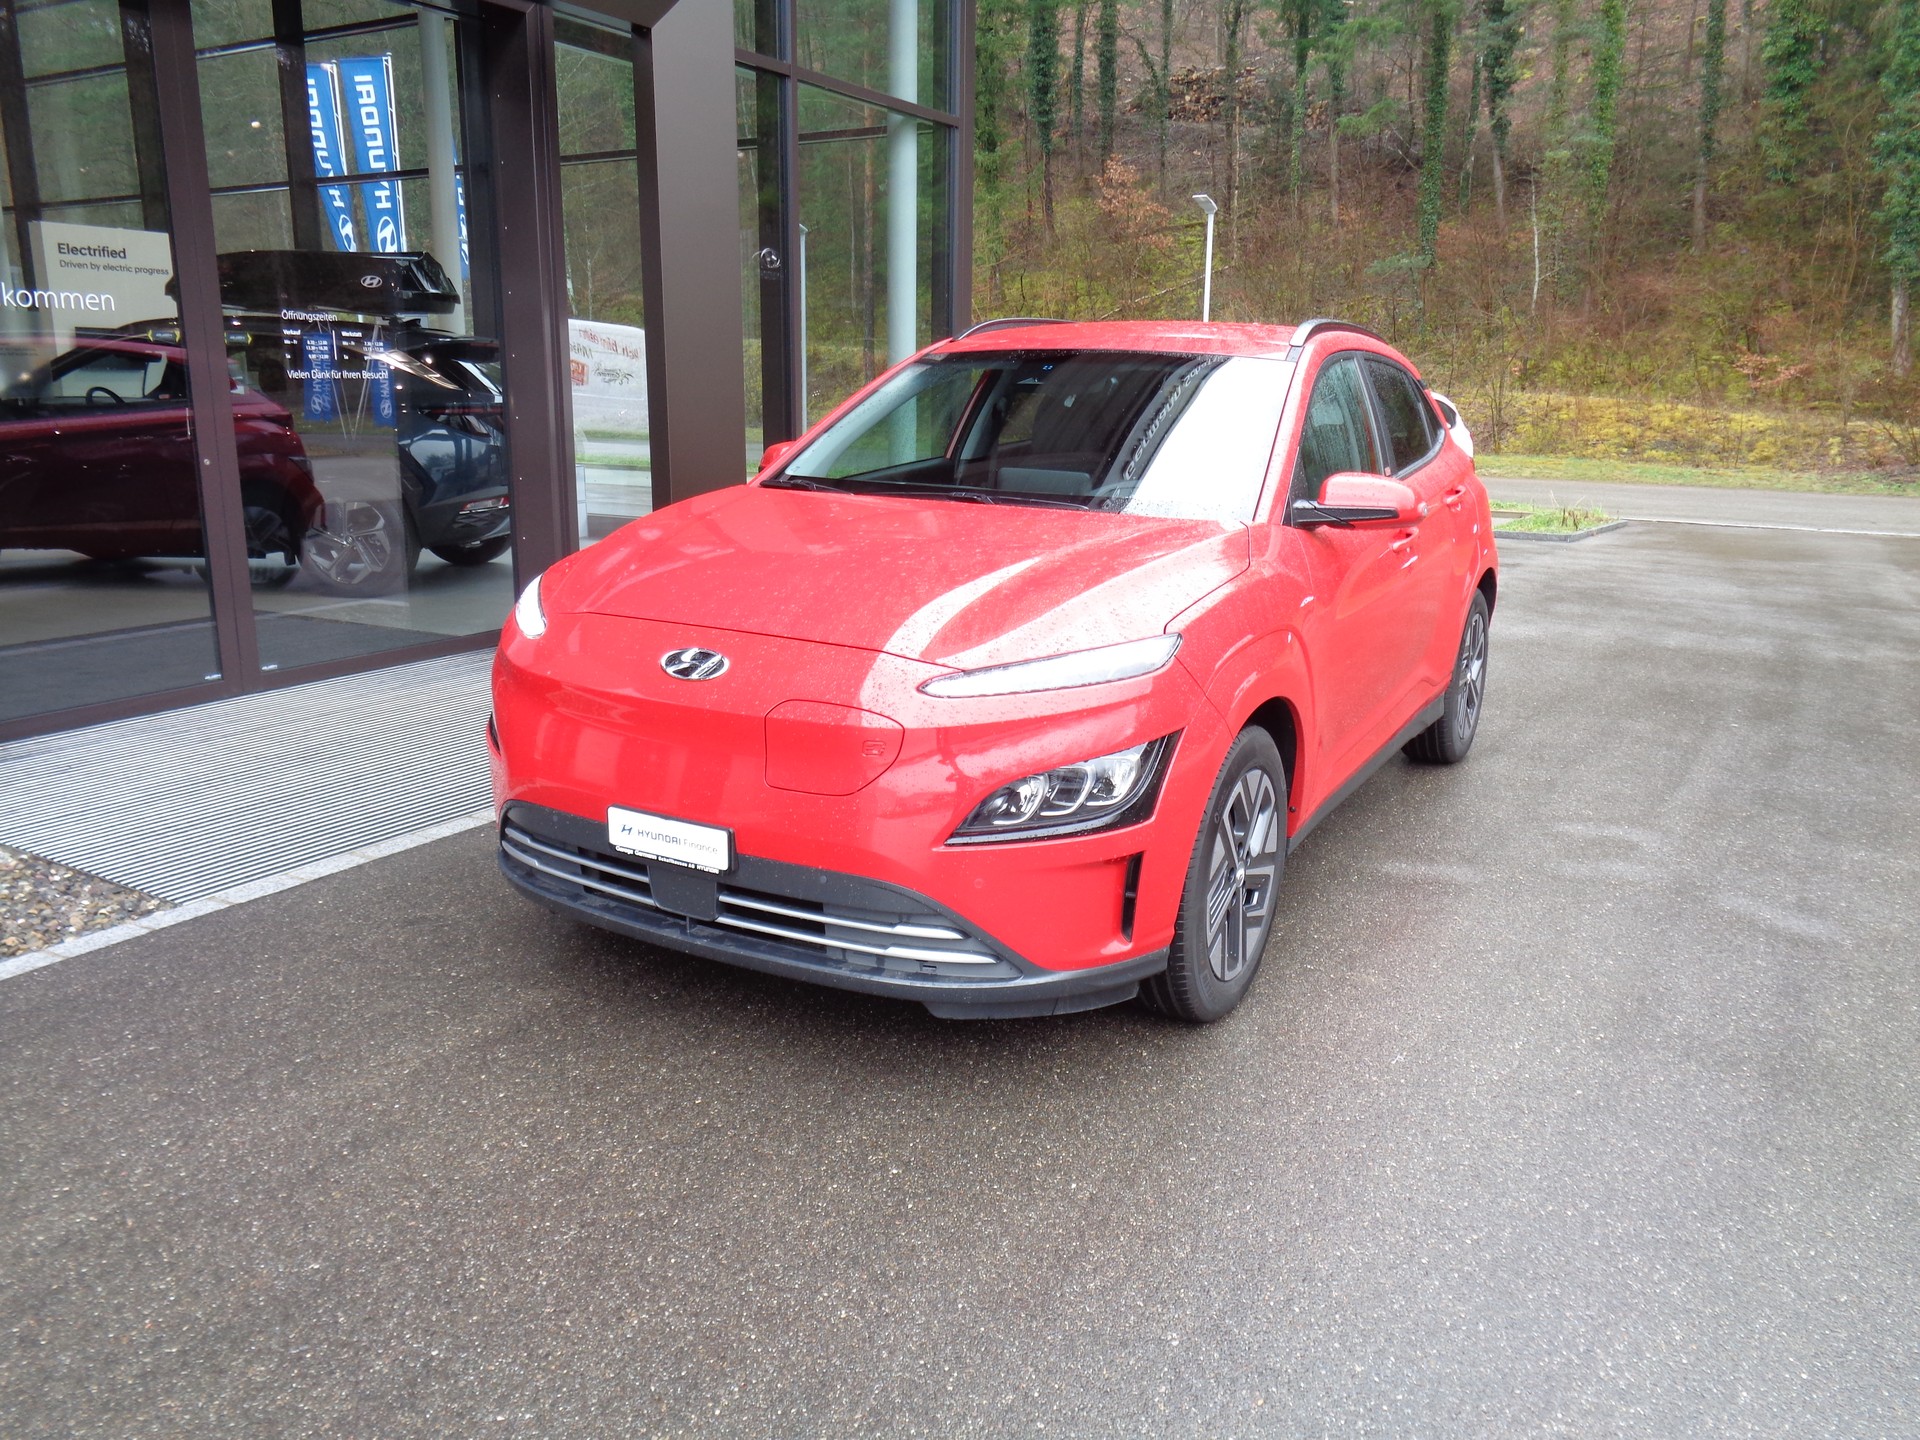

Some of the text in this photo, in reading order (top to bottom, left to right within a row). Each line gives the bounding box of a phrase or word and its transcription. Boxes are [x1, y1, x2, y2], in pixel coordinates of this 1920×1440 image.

[57, 242, 127, 260] Electrified
[59, 259, 169, 276] Driven by electric progress
[281, 309, 338, 323] Öffnungszeiten
[287, 370, 388, 379] Vielen Dank für Ihren Besuch!
[637, 829, 718, 854] HYUNDAI Finance
